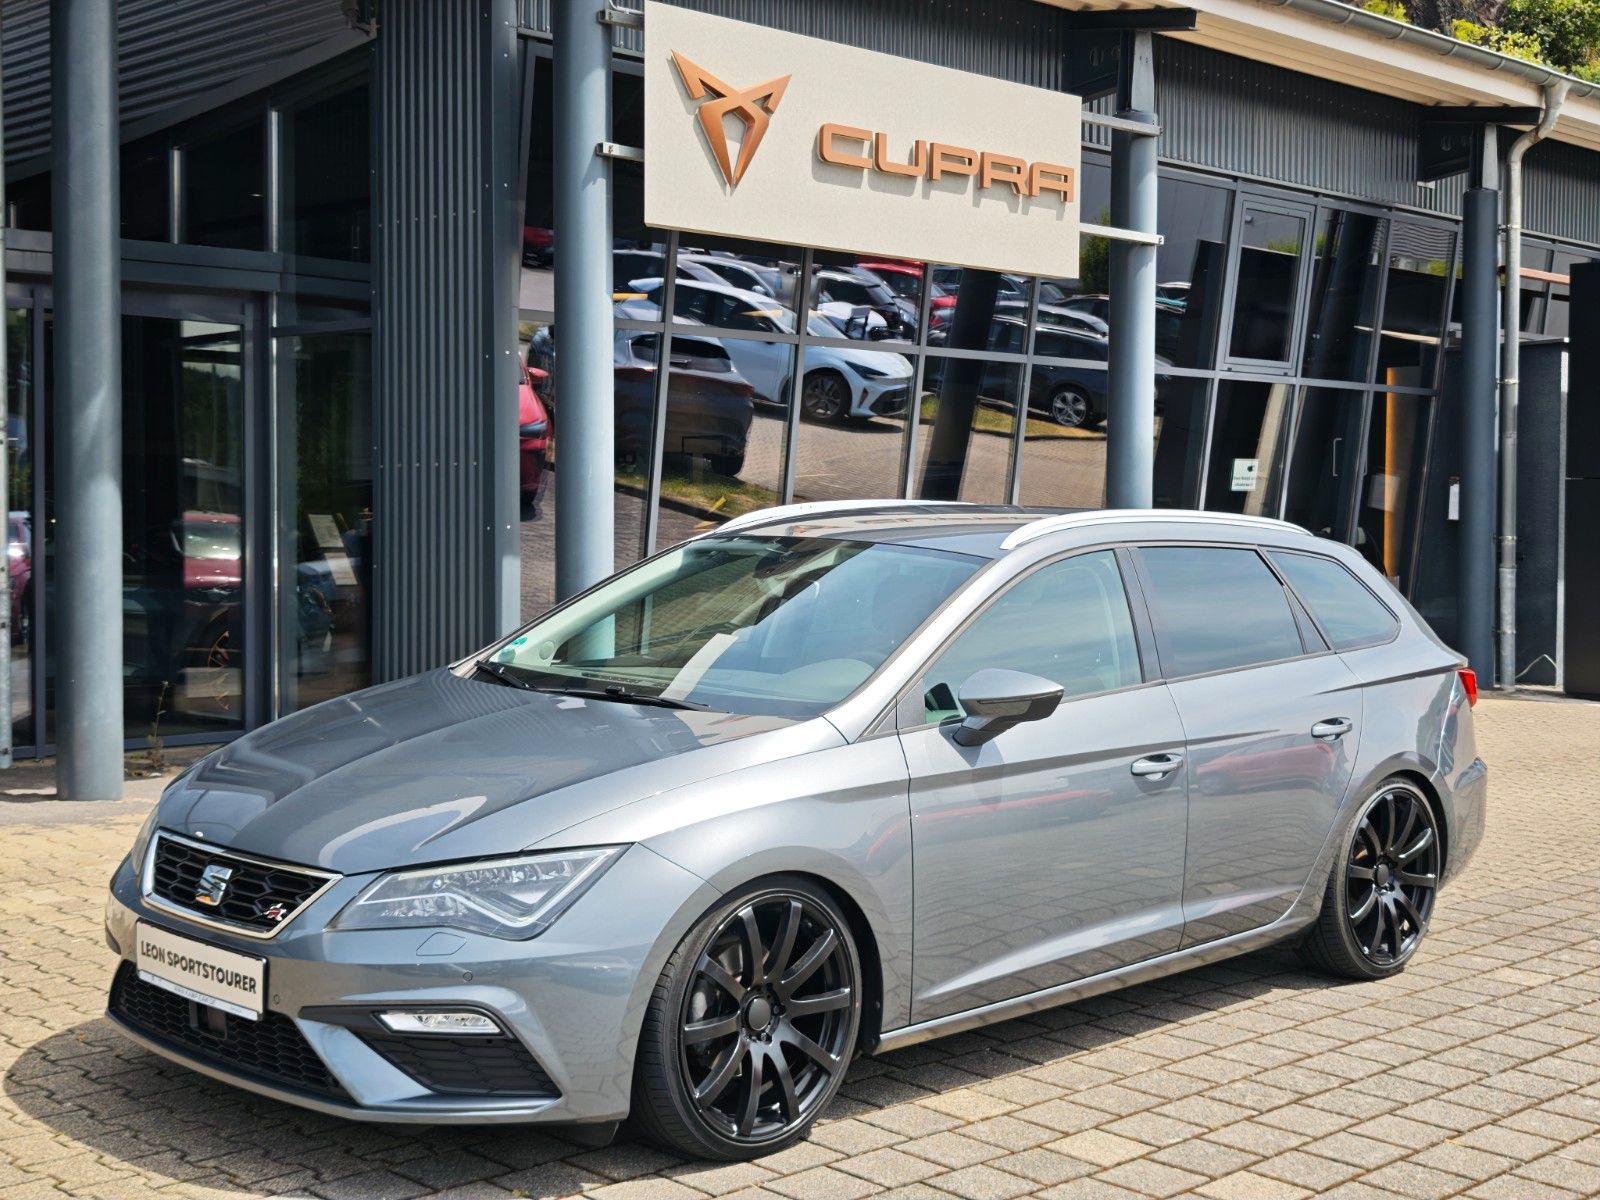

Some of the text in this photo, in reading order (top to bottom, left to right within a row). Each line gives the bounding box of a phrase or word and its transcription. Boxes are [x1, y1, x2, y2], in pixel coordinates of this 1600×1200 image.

[819, 122, 1074, 203] CUPRA
[141, 941, 257, 994] LEON SPORTSTOURER
